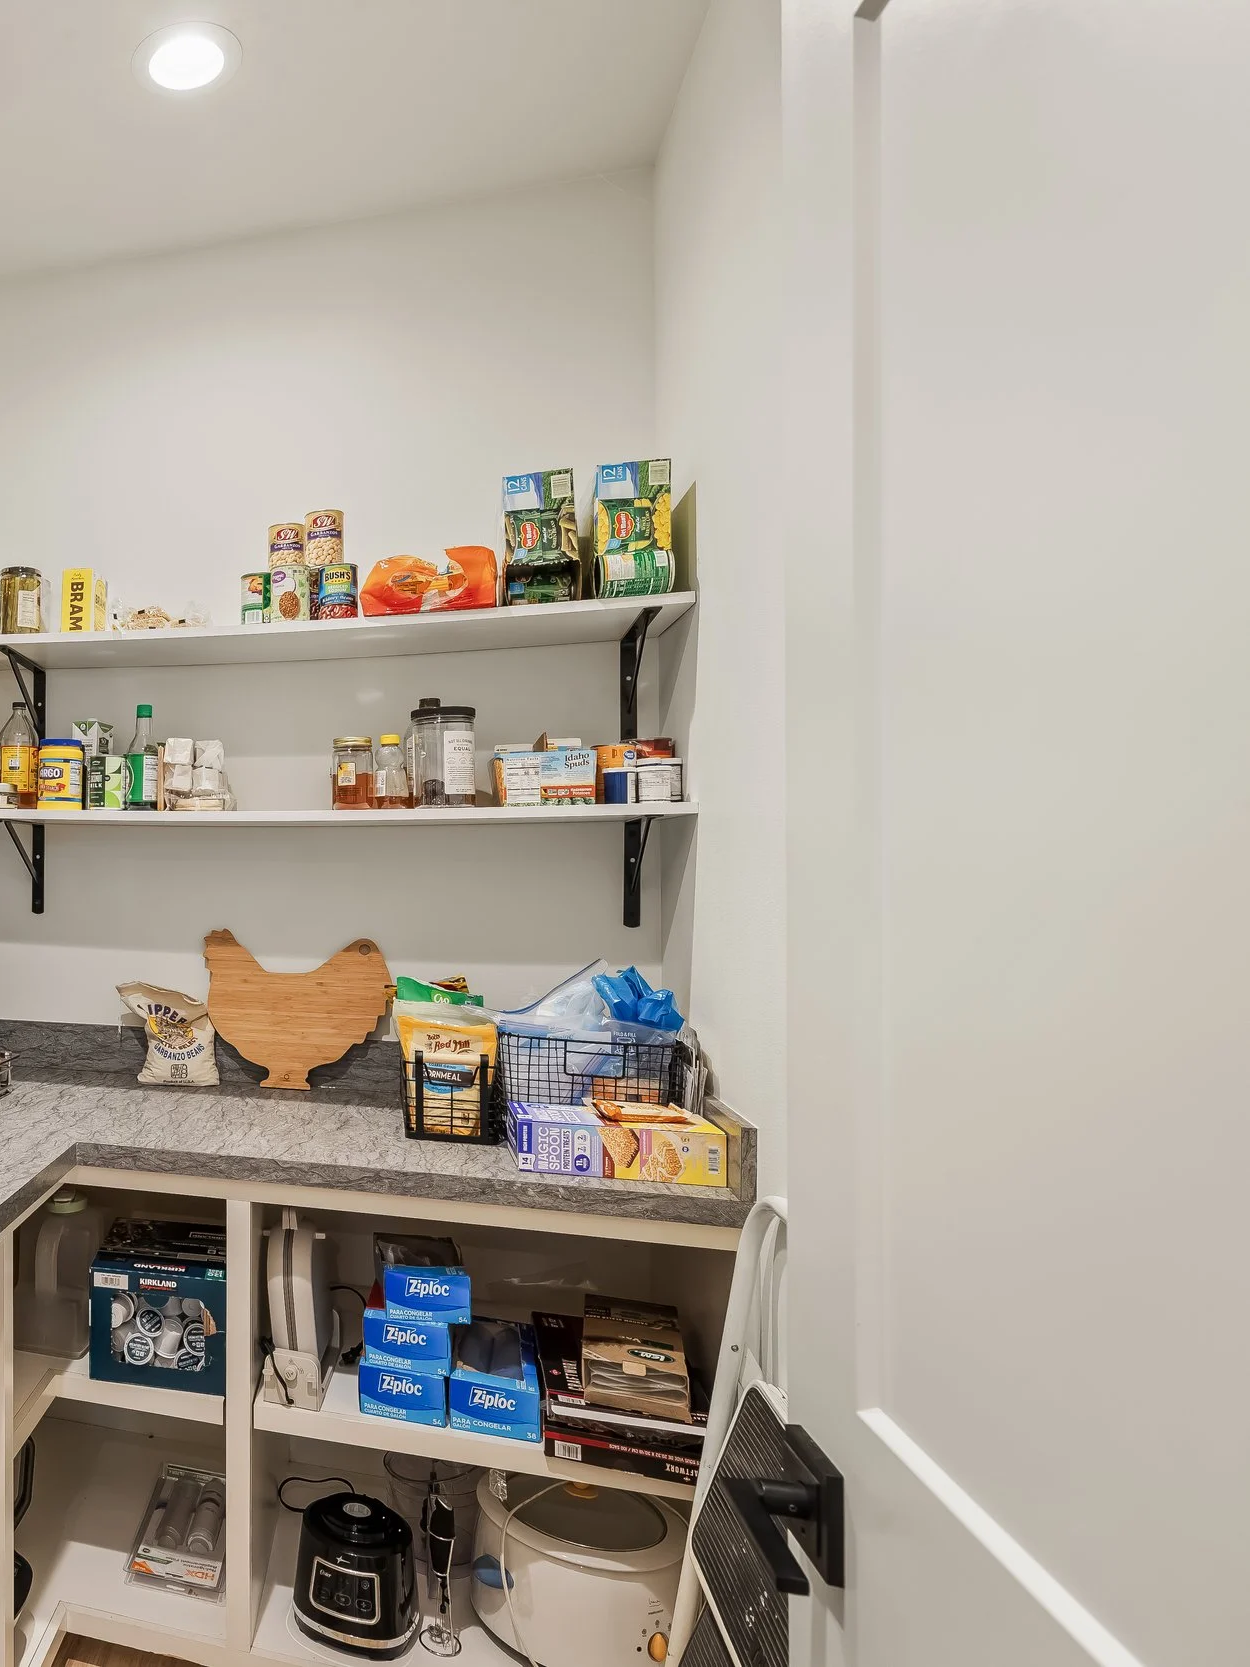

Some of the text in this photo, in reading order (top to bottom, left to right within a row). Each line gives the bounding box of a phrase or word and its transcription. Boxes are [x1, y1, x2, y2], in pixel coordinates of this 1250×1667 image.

[603, 466, 617, 481] 12
[507, 480, 521, 493] 12
[520, 476, 529, 492] CANS
[324, 570, 352, 582] BUSH'S
[68, 581, 84, 631] BRAM
[565, 752, 590, 762] Idaho
[564, 760, 590, 770] Spuds
[39, 767, 62, 778] ARGO
[153, 1042, 205, 1061] GARBANZO BEANS
[433, 1039, 471, 1054] Red Mill
[537, 1126, 550, 1170] MAGIC
[549, 1127, 561, 1171] SPOON
[562, 1130, 570, 1170] PROTEIN TREATS
[521, 1157, 529, 1166] 14
[133, 1263, 186, 1273] KIRKLAND
[139, 1277, 178, 1288] KIRKLAND
[408, 1278, 450, 1298] Ziploc
[403, 1310, 433, 1318] CONGELAR
[385, 1326, 427, 1347] Ziploc
[368, 1353, 412, 1366] PARA CONGELAR
[437, 1368, 447, 1376] 54
[381, 1375, 423, 1396] Ziploc
[472, 1389, 517, 1411] Ziploc
[363, 1402, 407, 1415] PARA CONGELAR
[432, 1418, 442, 1426] 54
[452, 1416, 512, 1432] PARA CONGELAR
[526, 1431, 537, 1440] 38
[180, 1558, 218, 1569] Replacement
[184, 1569, 216, 1582] HDX
